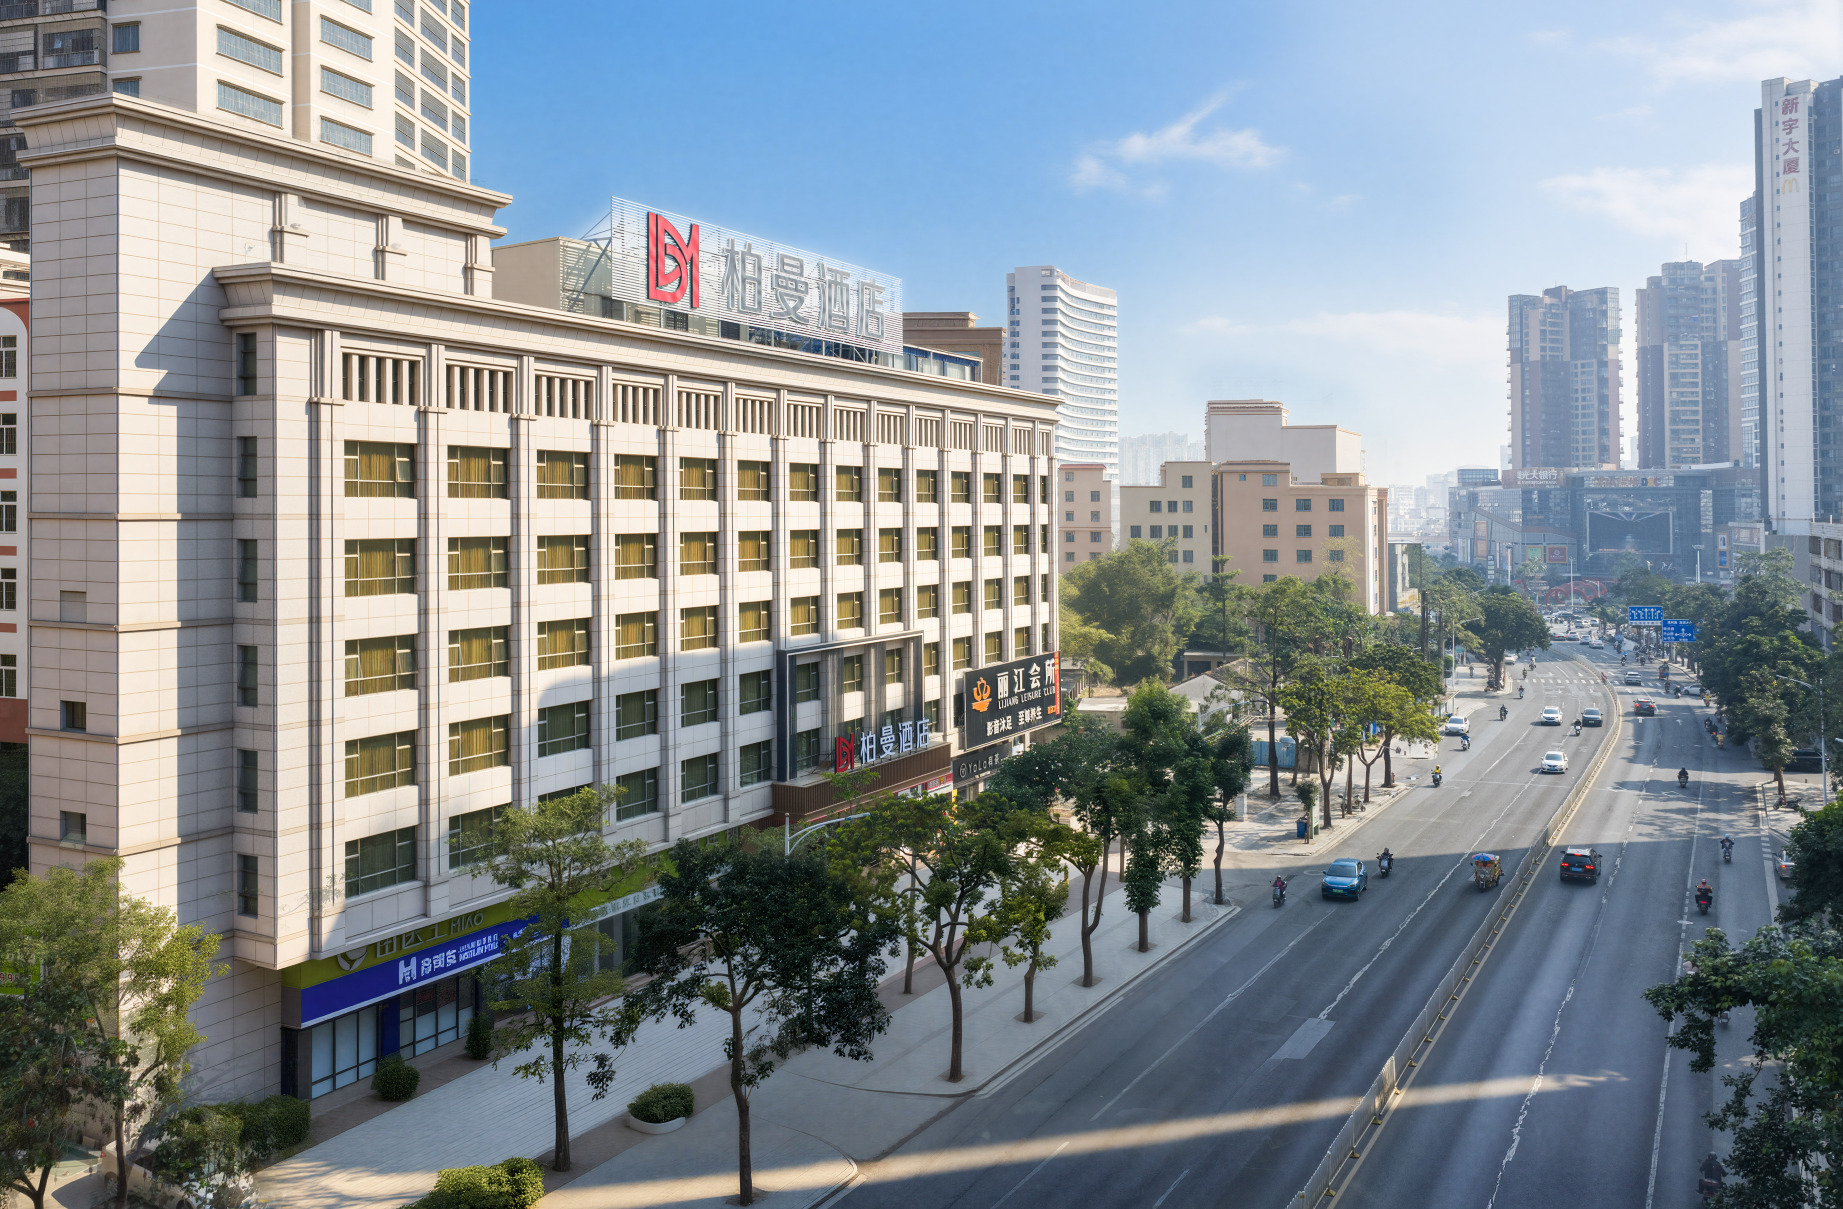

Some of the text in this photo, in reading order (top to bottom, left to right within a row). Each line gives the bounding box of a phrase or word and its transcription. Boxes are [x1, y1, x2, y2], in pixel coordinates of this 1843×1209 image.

[722, 238, 885, 341] 柏曼酒店
[996, 658, 1055, 699] 丽江会所
[998, 696, 1019, 710] LIJIANG
[1021, 689, 1041, 703] LEISURE
[860, 718, 929, 764] 柏曼酒店
